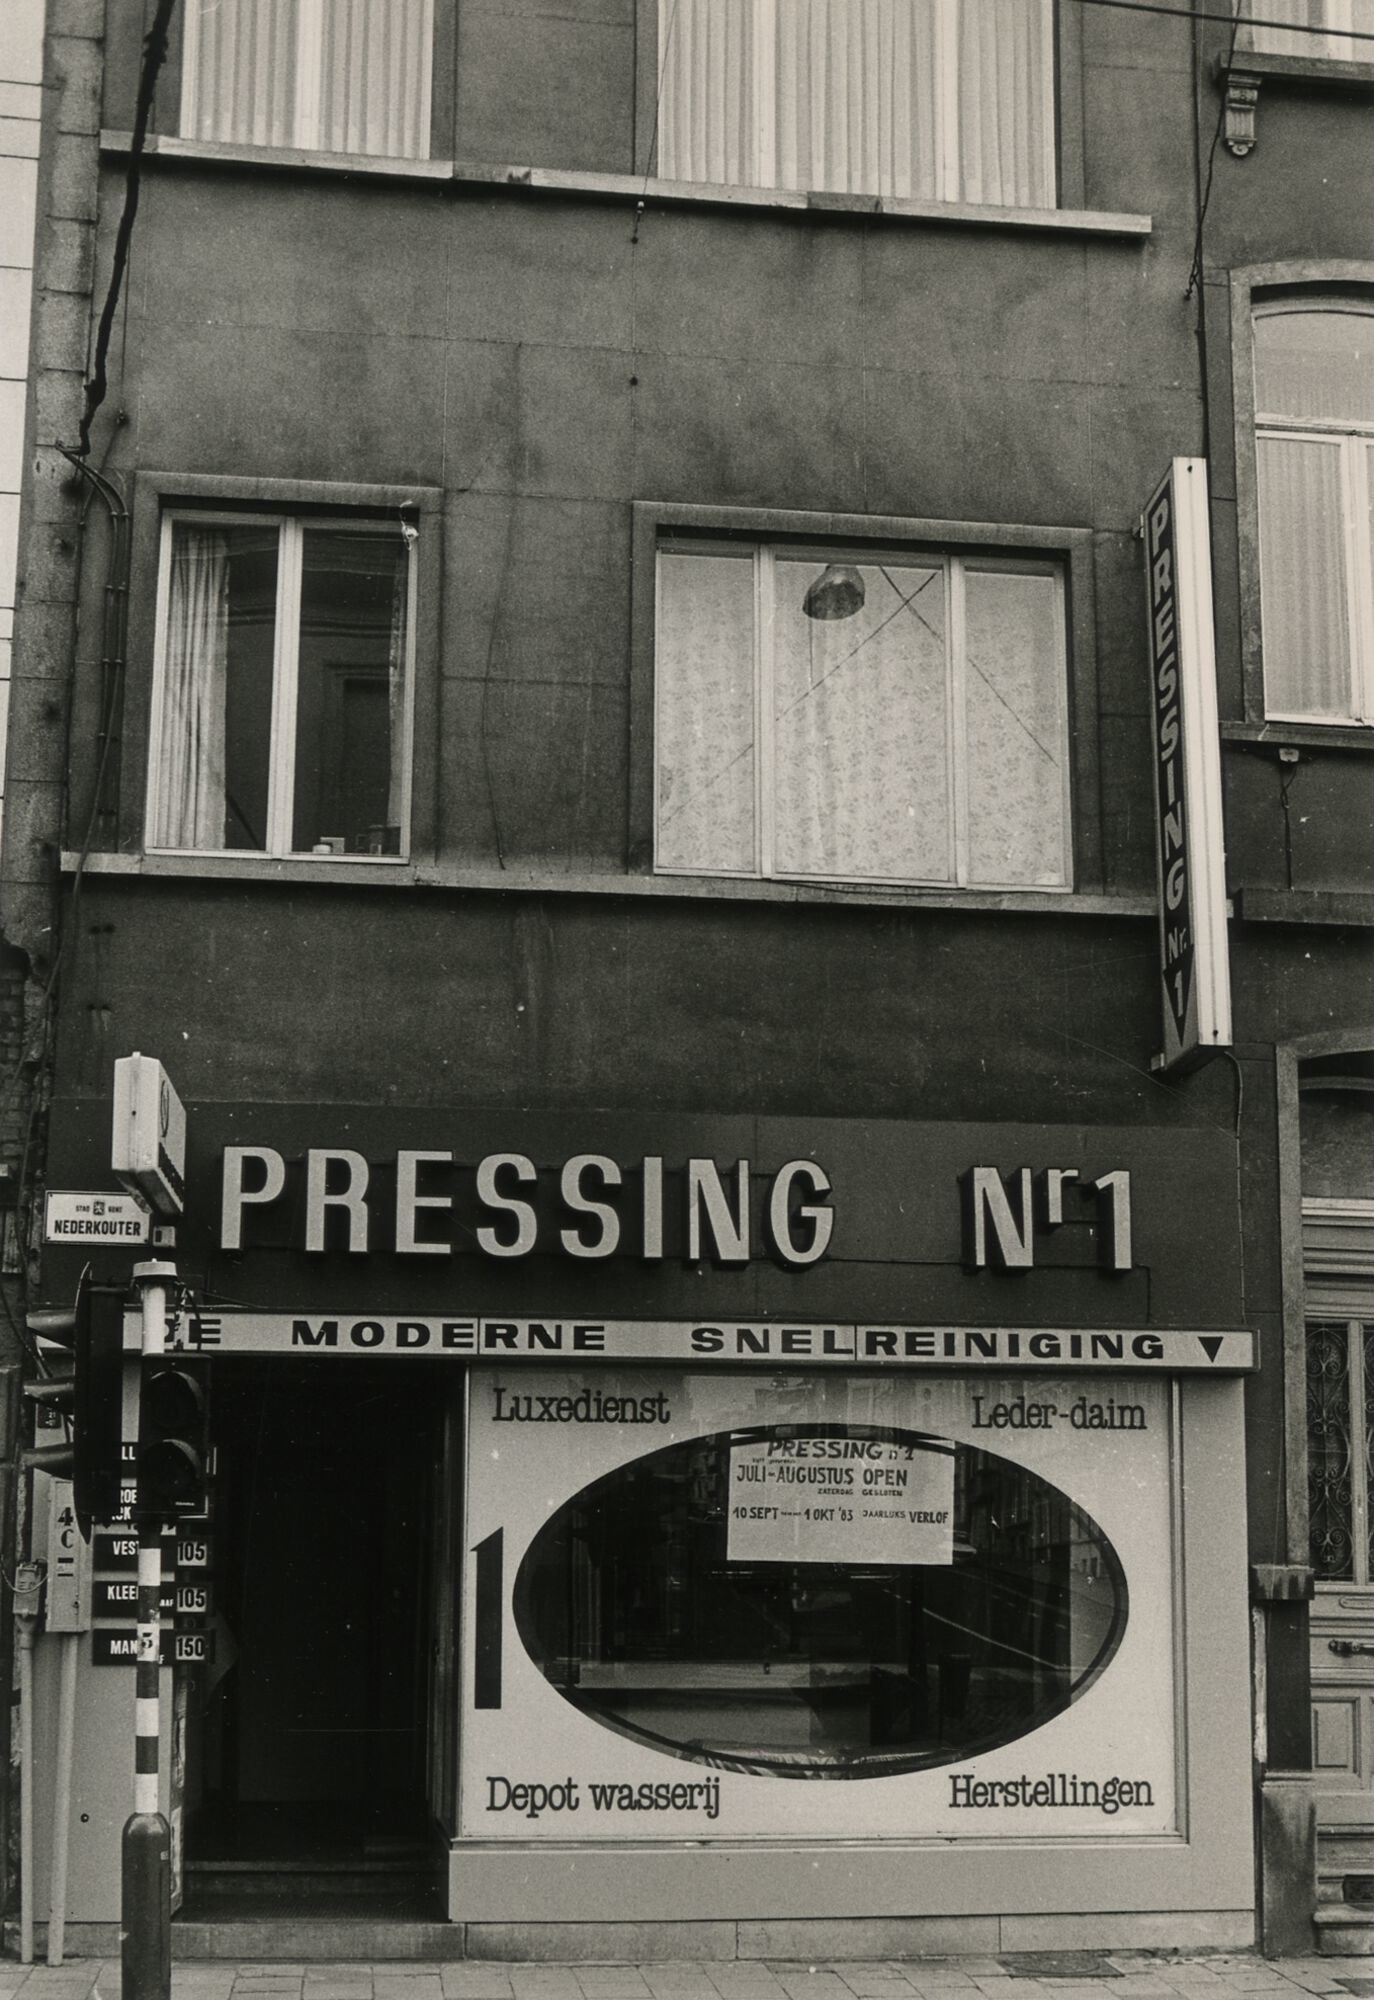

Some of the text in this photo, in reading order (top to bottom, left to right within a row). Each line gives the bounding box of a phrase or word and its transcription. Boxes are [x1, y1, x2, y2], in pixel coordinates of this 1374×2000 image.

[1148, 511, 1183, 911] PRESSING
[1174, 969, 1184, 1018] 1
[221, 1146, 834, 1264] PRESSING
[54, 1220, 141, 1236] NEDERKOUTER
[292, 1320, 606, 1351] MODERNE
[491, 1388, 671, 1424] Luxedienst
[971, 1396, 1148, 1430] Leder-daim
[767, 1440, 882, 1459] PRESSING
[736, 1464, 907, 1486] JULI-AUGUSTUS OPEN
[749, 1507, 779, 1520] SEPT
[813, 1509, 835, 1521] OKT
[909, 1511, 949, 1524] VERLOF
[178, 1542, 207, 1561] 105
[178, 1588, 206, 1608] 105
[177, 1637, 205, 1657] 150
[486, 1777, 720, 1818] Depot wasserij
[948, 1774, 1154, 1814] Herstellingen
